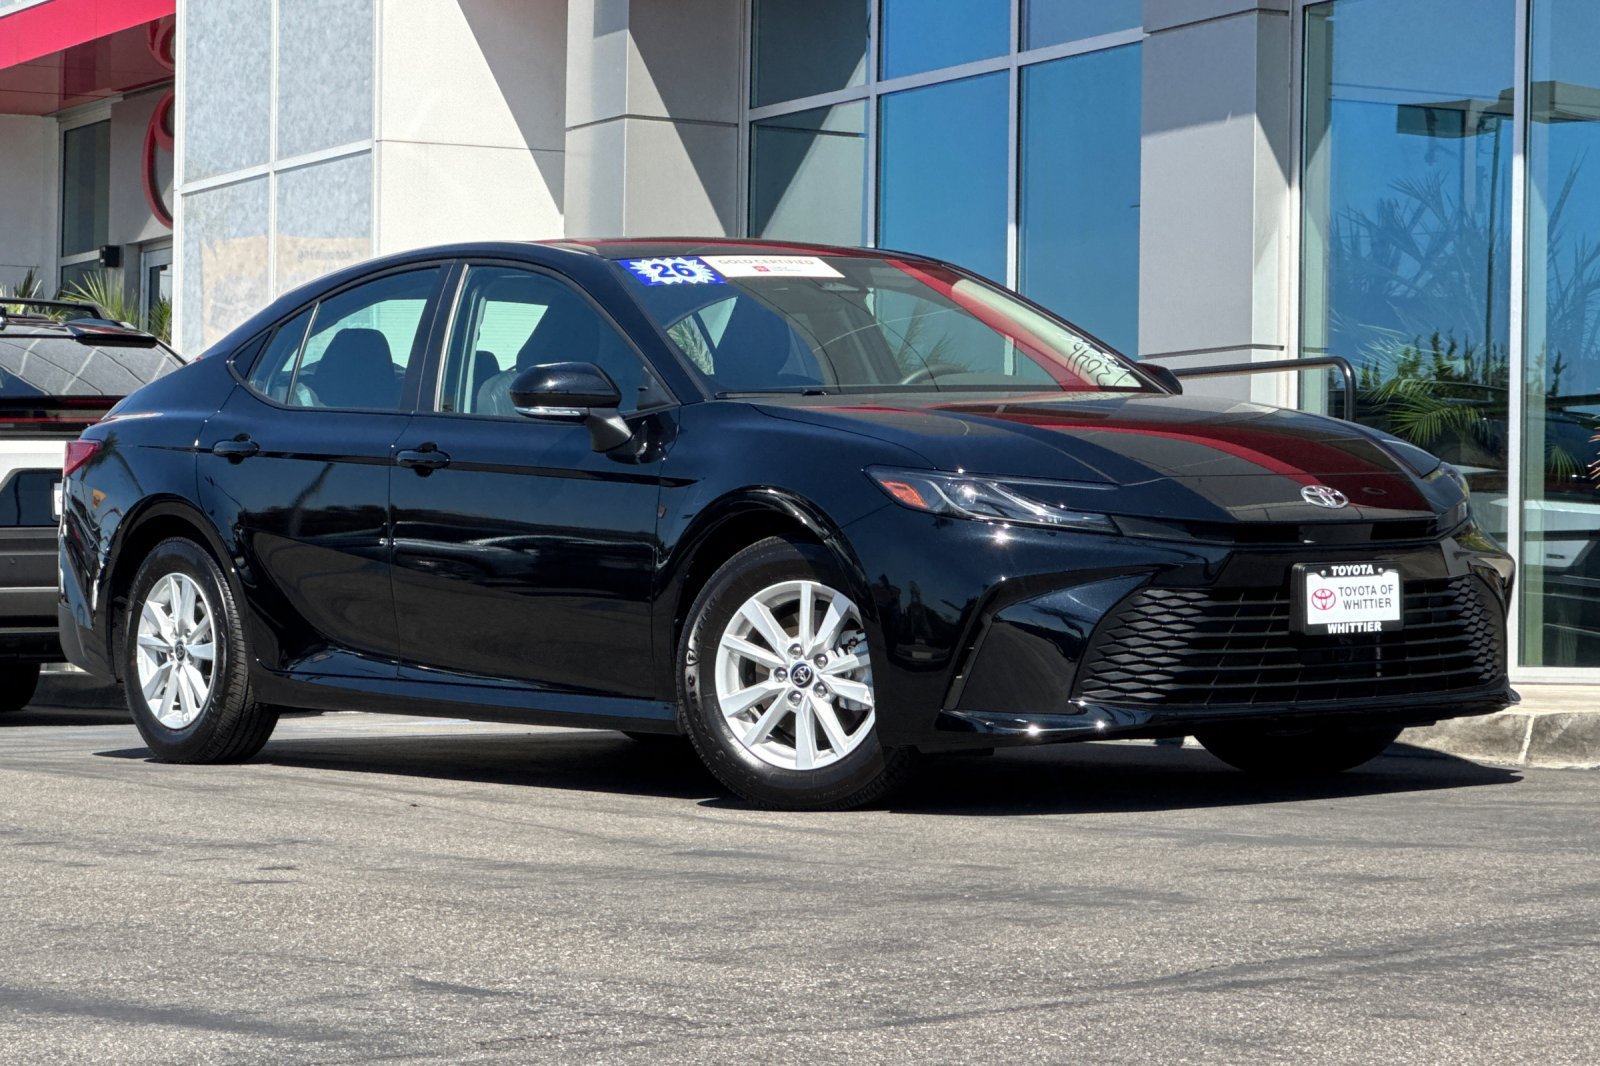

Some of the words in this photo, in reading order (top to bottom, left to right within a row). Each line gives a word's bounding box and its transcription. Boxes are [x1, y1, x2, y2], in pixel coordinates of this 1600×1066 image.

[650, 262, 697, 278] 26
[1331, 564, 1374, 576] TOYOTA
[1338, 585, 1377, 597] TOYOTA
[1380, 584, 1394, 595] OF
[1343, 598, 1392, 610] WHITTIER
[1327, 621, 1382, 634] WHITTIER
